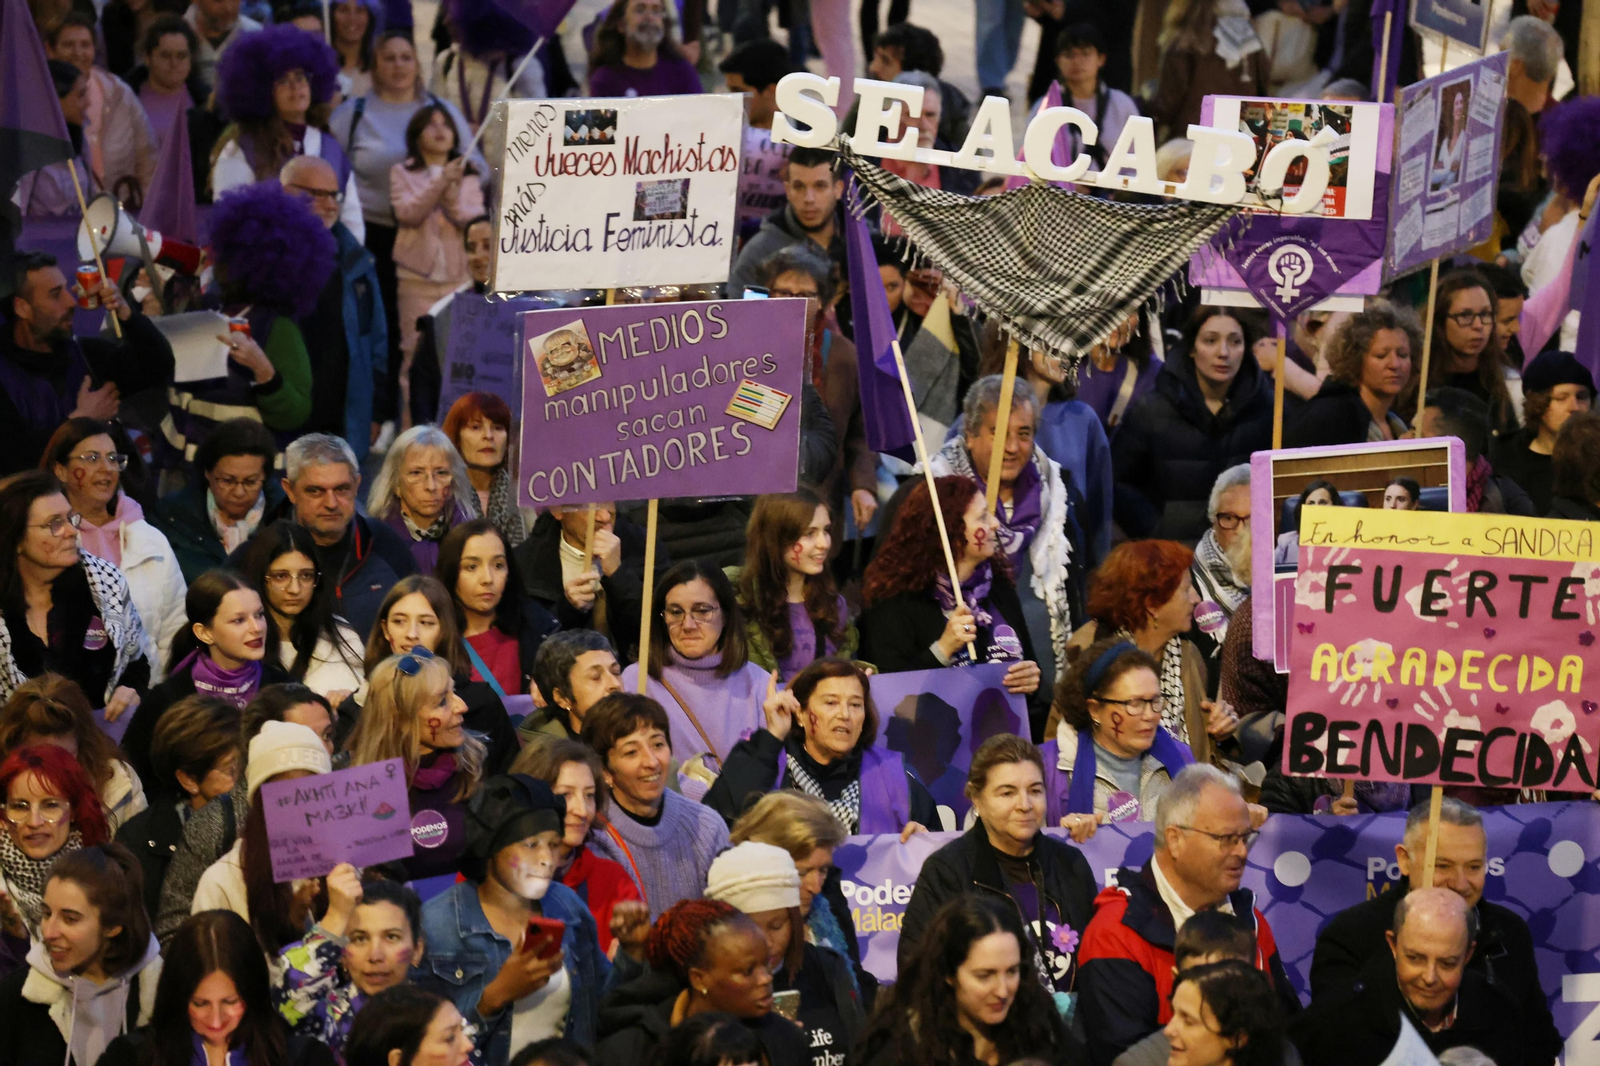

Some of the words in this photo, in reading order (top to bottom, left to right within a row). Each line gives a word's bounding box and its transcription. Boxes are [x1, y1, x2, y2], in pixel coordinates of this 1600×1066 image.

[507, 104, 556, 163] menos
[535, 133, 617, 177] Jueces
[623, 132, 737, 176] Machistas
[505, 182, 546, 226] más
[501, 213, 593, 254] Justicia
[598, 304, 729, 364] MEDIOS
[544, 353, 778, 421] manipuladores
[616, 404, 707, 441] sacan
[528, 421, 752, 502] CONTADORES
[1301, 521, 1338, 545] En
[1345, 520, 1450, 546] honor
[1461, 535, 1475, 547] a
[1481, 526, 1594, 558] SANDRA
[1325, 564, 1586, 620] FUERTE
[1310, 642, 1584, 694] AGRADECIDA
[1289, 711, 1597, 788] BENDECIDA
[410, 821, 447, 835] PODEMOS
[840, 878, 915, 906] Pode
